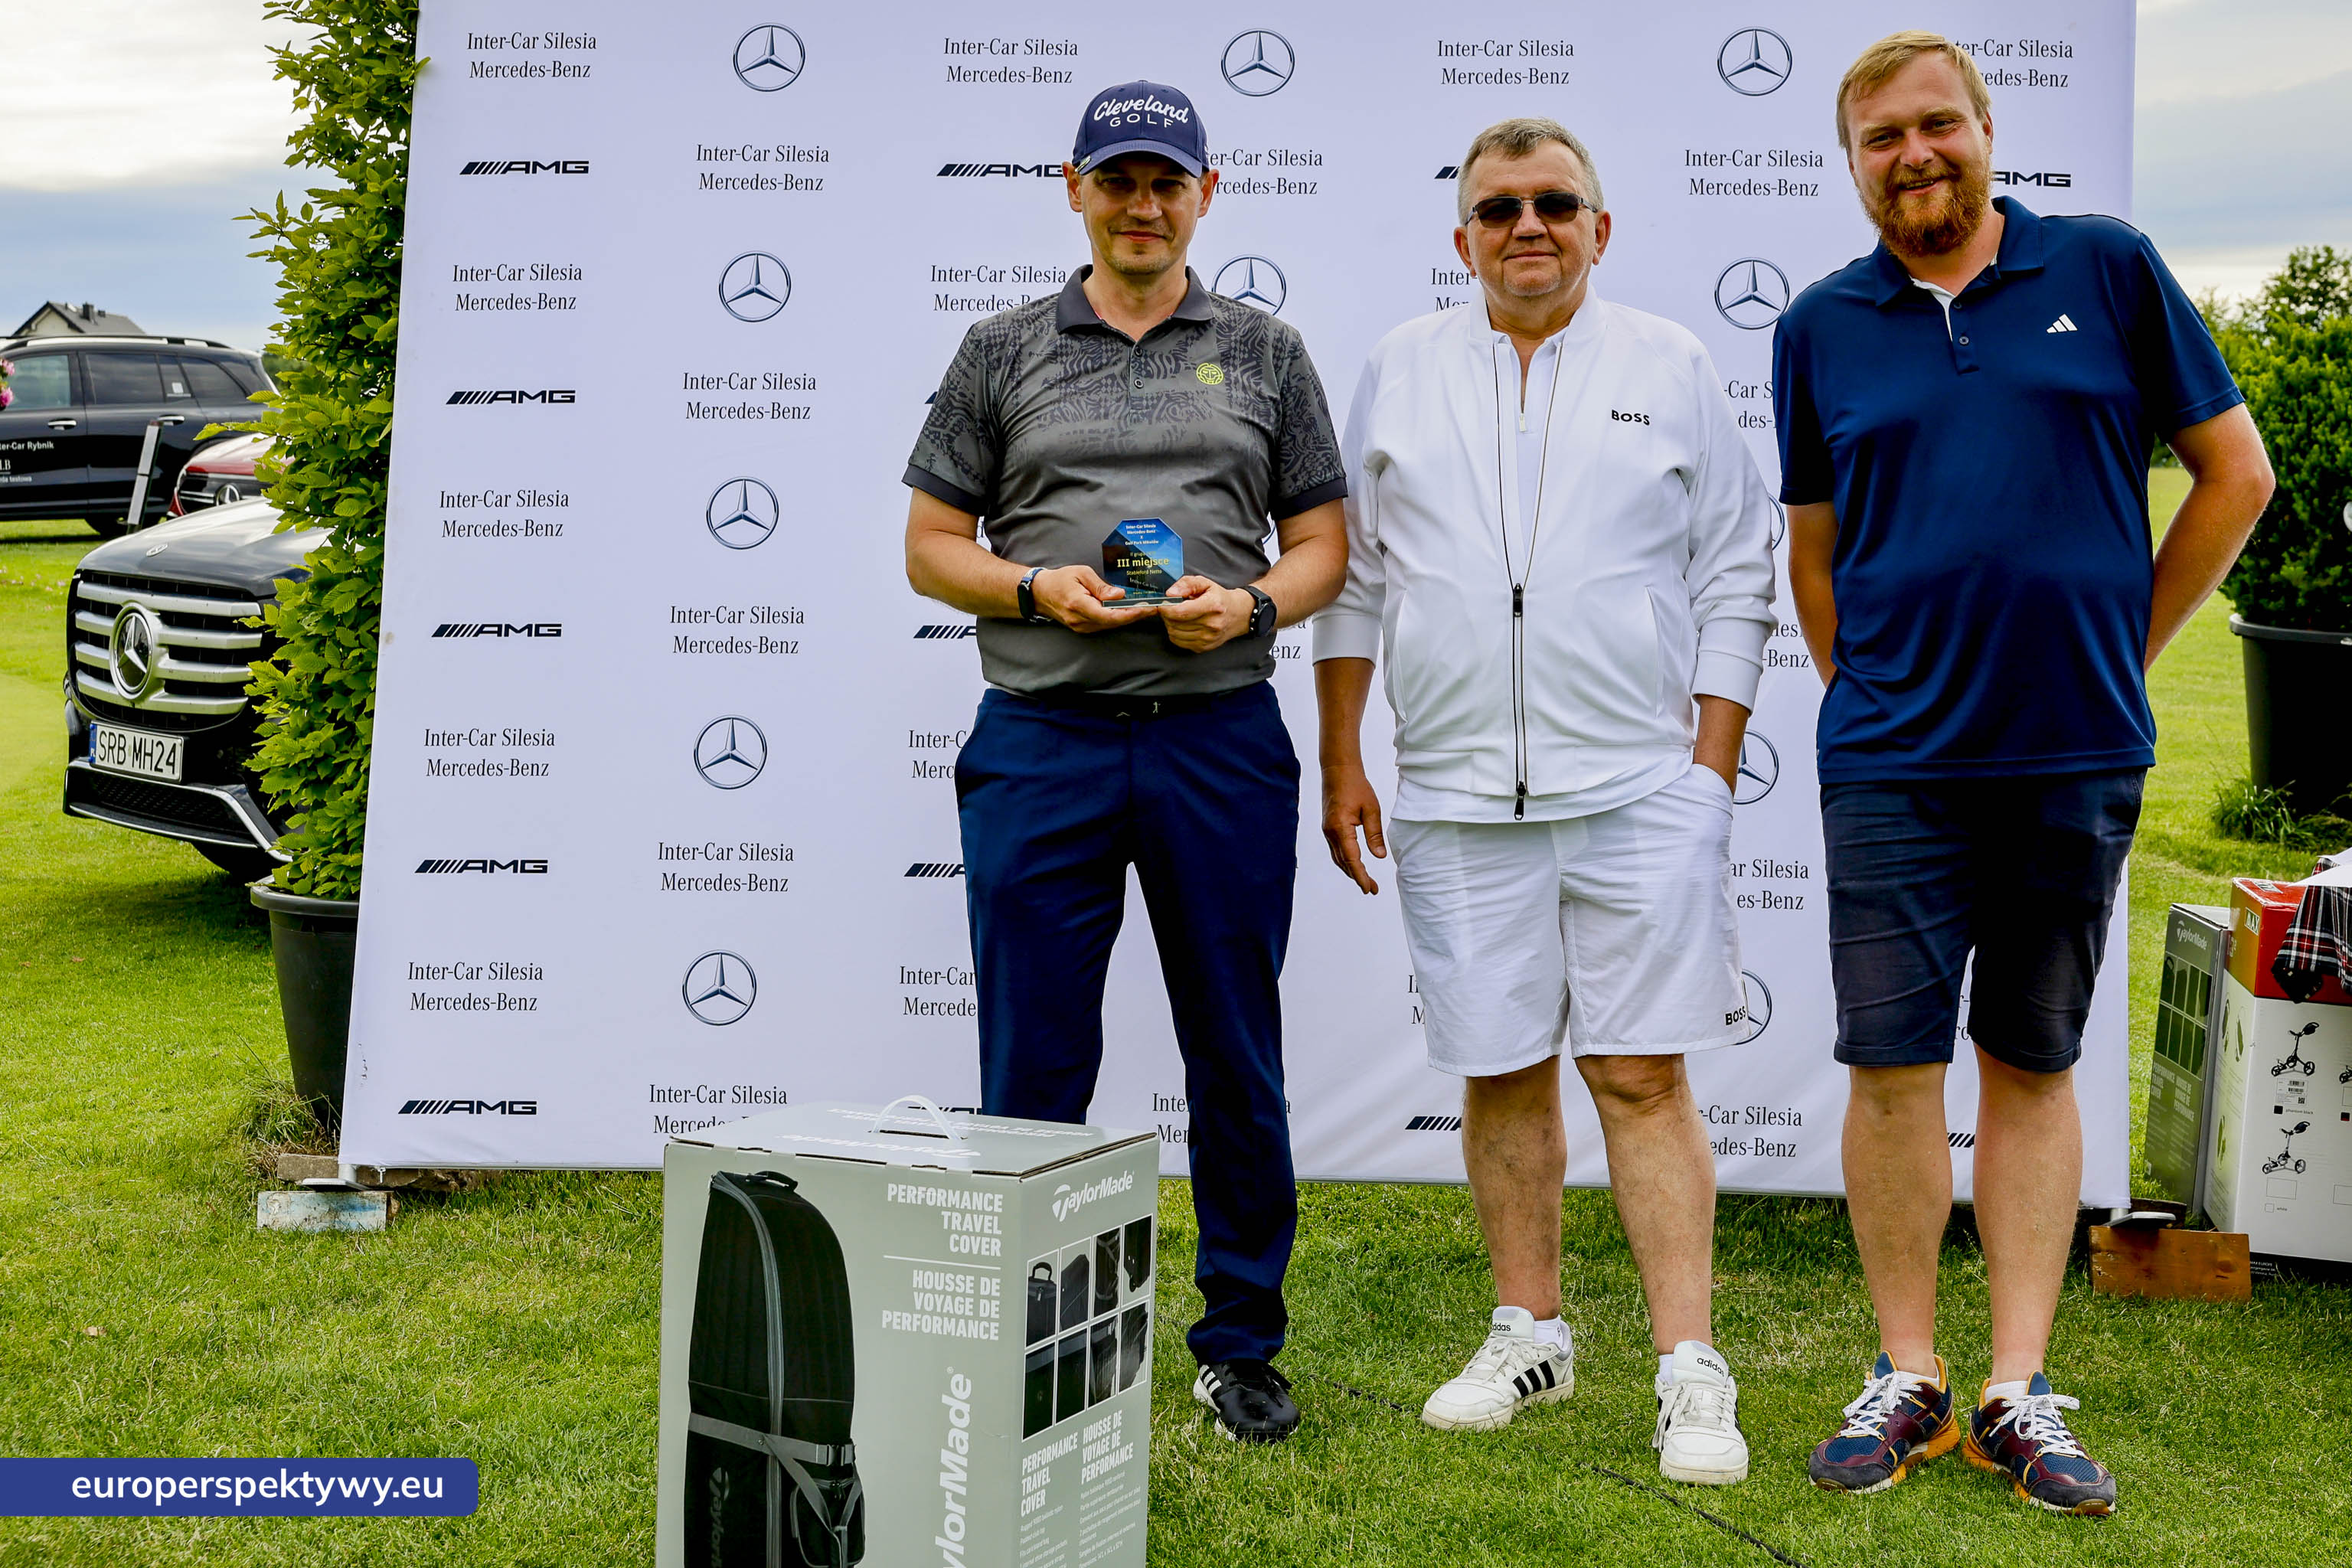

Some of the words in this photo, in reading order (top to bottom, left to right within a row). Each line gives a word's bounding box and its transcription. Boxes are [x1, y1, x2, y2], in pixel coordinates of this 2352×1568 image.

[468, 32, 539, 49] Inter-Car
[544, 32, 596, 49] Silesia
[944, 38, 1018, 54] Inter-Car
[1024, 39, 1077, 55] Silesia
[1438, 40, 1513, 57] Inter-Car
[1519, 40, 1573, 56] Silesia
[2019, 40, 2073, 58] Silesia
[470, 60, 590, 78] Mercedes-Benz
[947, 66, 1072, 83] Mercedes-Benz
[1442, 68, 1569, 84] Mercedes-Benz
[1093, 94, 1189, 124] Cleveland
[1109, 113, 1174, 128] GOLF
[697, 145, 770, 162] Inter-Car
[776, 145, 828, 162] Silesia
[1268, 149, 1322, 166] Silesia
[1685, 149, 1762, 166] Inter-Car
[1768, 150, 1823, 167] Silesia
[502, 160, 590, 175] AMG
[699, 173, 823, 191] Mercedes-Benz
[1214, 176, 1318, 195] rcedes-Benz
[1690, 178, 1818, 196] Mercedes-Benz
[453, 264, 524, 282] Inter-Car
[530, 263, 582, 280] Silesia
[931, 265, 1006, 283] Inter-Car
[1012, 265, 1067, 284] Silesia
[456, 293, 576, 311] Mercedes-Benz
[683, 373, 756, 390] Inter-Car
[763, 373, 815, 390] Silesia
[490, 389, 576, 404] AMG
[686, 402, 810, 419] Mercedes-Benz
[1611, 409, 1651, 426] BOSS
[27, 441, 54, 451] Rybnik
[440, 490, 511, 508] Inter-Car
[517, 490, 568, 507] Silesia
[442, 519, 563, 537] Mercedes-Benz
[1117, 559, 1130, 567] III
[1132, 557, 1170, 567] miejsce
[671, 606, 744, 624] Inter-Car
[750, 606, 804, 624] Silesia
[475, 622, 563, 638] AMG
[673, 635, 799, 654] Mercedes-Benz
[424, 728, 496, 746] Inter-Car
[502, 728, 554, 746] Silesia
[98, 730, 126, 765] SRB
[132, 737, 177, 775] MH24
[426, 759, 549, 776] Mercedes-Benz
[658, 842, 733, 861] Inter-Car
[739, 843, 793, 861] Silesia
[459, 859, 548, 874] AMG
[1753, 859, 1808, 879] Silesia
[662, 873, 788, 891] Mercedes-Benz
[408, 962, 483, 980] Inter-Car
[488, 962, 543, 980] Silesia
[410, 992, 537, 1011] Mercedes-Benz
[1725, 1005, 1746, 1026] BOSS
[649, 1084, 726, 1103] Inter-Car
[732, 1086, 787, 1104] Silesia
[447, 1100, 538, 1116] AMG
[1745, 1106, 1802, 1126] Silesia
[887, 1183, 1003, 1214] PERFORMANCE
[1051, 1170, 1135, 1222] TaylorMade
[941, 1211, 1001, 1234] TRAVEL
[949, 1233, 1001, 1256] COVER
[912, 1269, 975, 1294] HOUSSE
[980, 1276, 1000, 1297] DE
[913, 1292, 975, 1317] VOYAGE
[979, 1298, 999, 1318] DE
[882, 1310, 999, 1341] PERFORMANCE
[1697, 1357, 1725, 1377] adidas
[1083, 1415, 1112, 1445] HOUSSE
[1112, 1410, 1122, 1429] DE
[1022, 1432, 1078, 1475] PERFORMANCE
[1083, 1436, 1109, 1464] VOYAGE
[1112, 1430, 1121, 1449] DE
[1081, 1442, 1134, 1485] PERFORMANCE
[1021, 1466, 1050, 1496] TRAVEL
[1021, 1489, 1046, 1517] COVER
